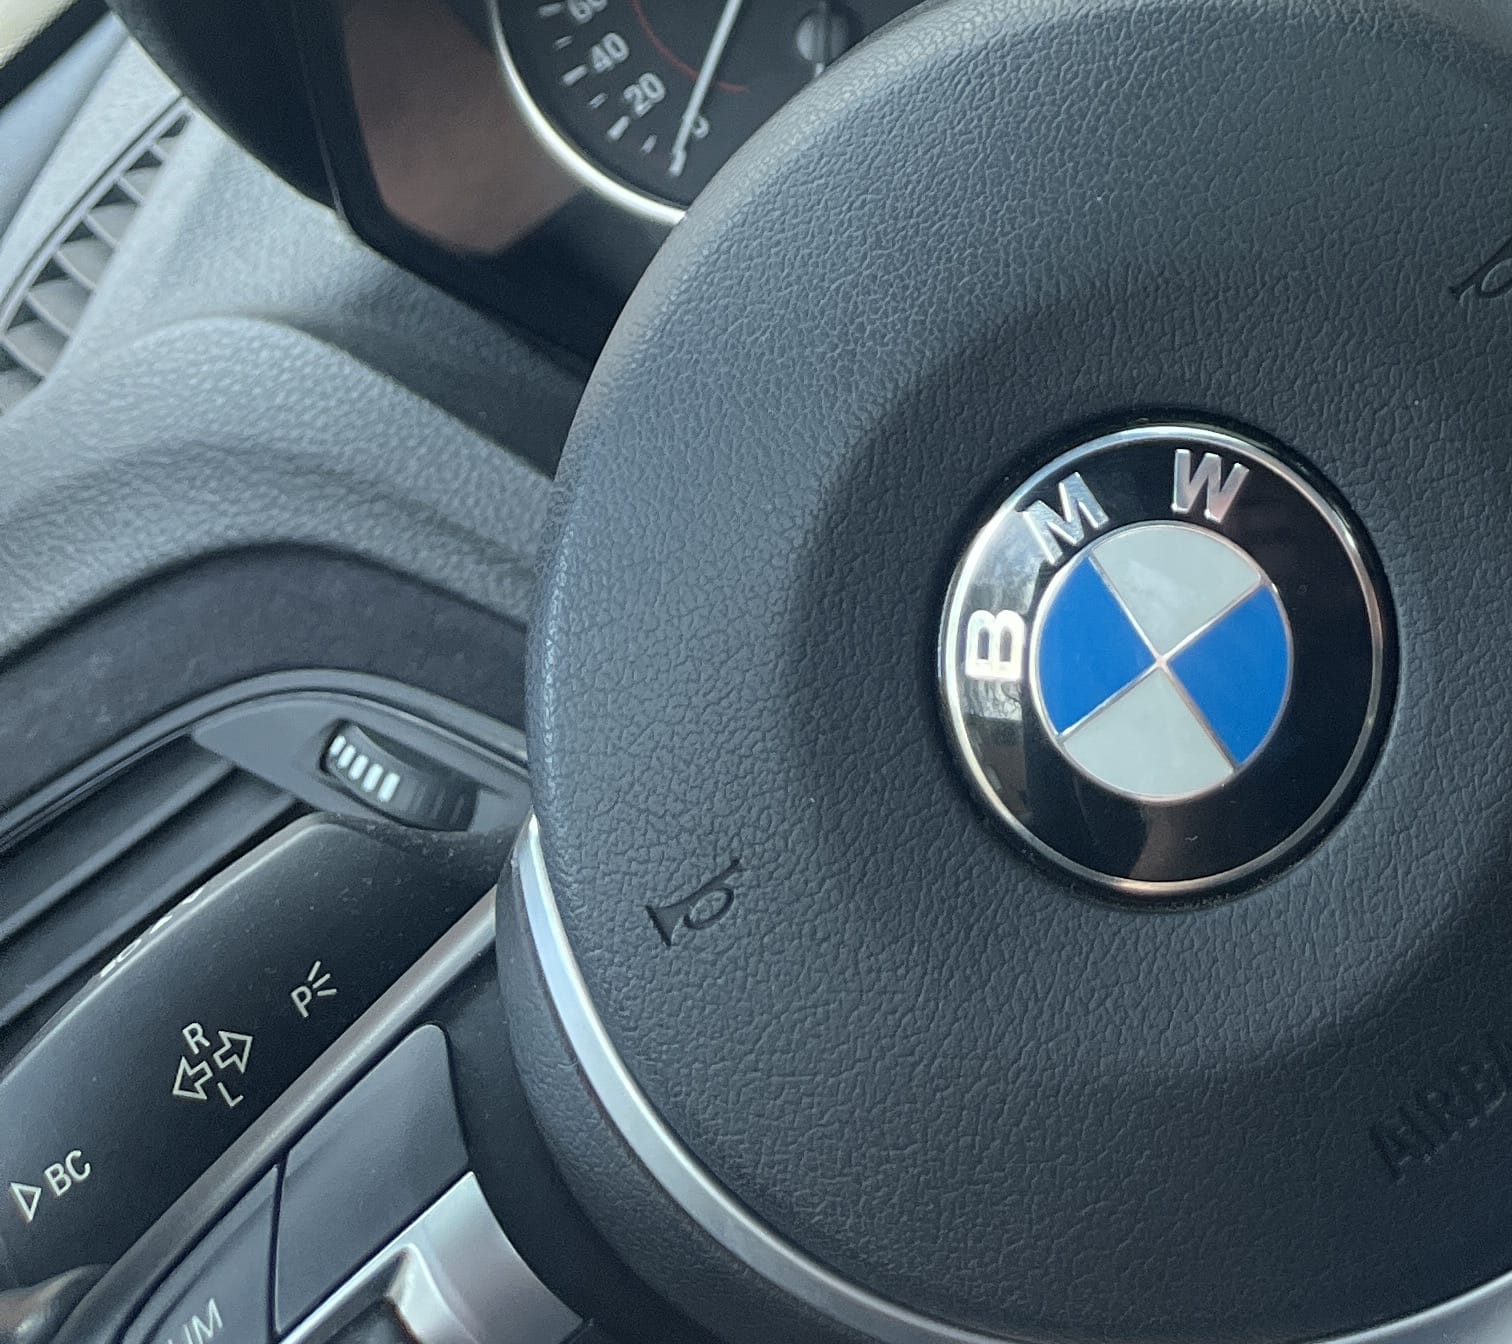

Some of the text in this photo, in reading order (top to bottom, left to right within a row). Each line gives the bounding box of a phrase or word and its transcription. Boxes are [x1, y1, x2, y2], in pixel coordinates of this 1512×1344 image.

[589, 30, 630, 76] 40
[623, 72, 667, 118] 20
[964, 448, 1251, 683] BMW
[181, 1021, 211, 1055] R
[217, 1081, 244, 1108] L
[44, 1148, 93, 1197] BC
